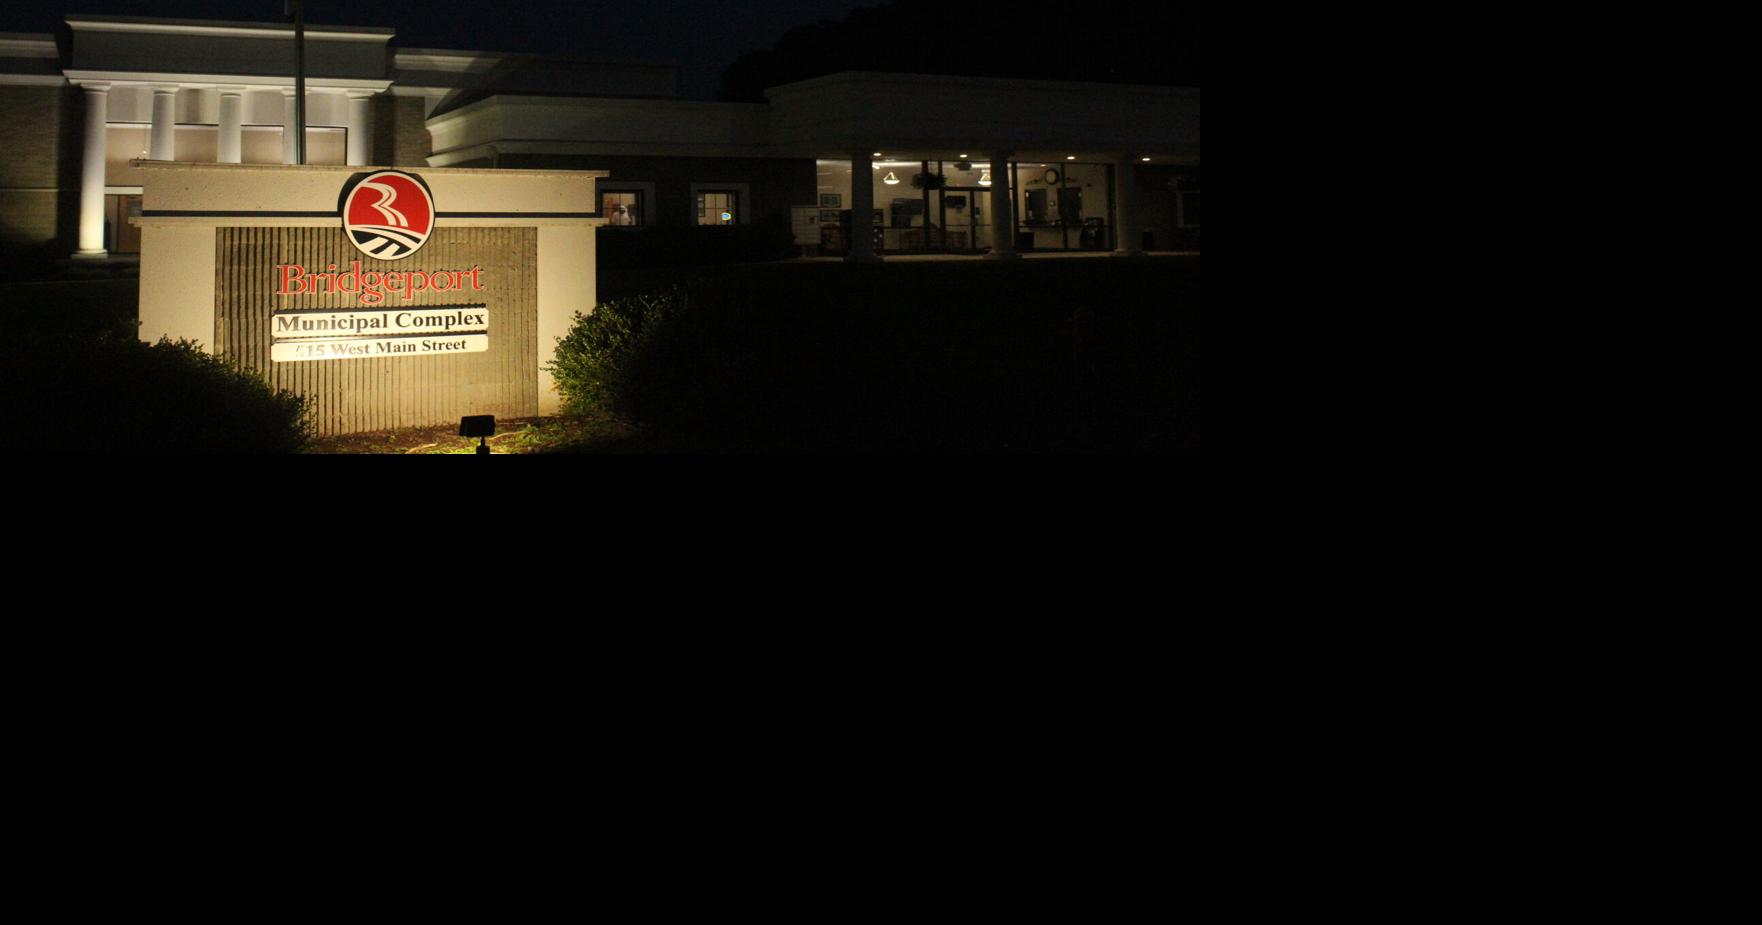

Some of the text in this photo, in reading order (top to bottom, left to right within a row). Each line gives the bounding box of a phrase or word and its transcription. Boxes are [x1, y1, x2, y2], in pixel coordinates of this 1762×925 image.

[276, 260, 485, 305] Bridgeport
[276, 312, 485, 333] Municipal Complex
[331, 343, 370, 355] West
[376, 341, 416, 354] Main
[422, 339, 467, 351] Street
